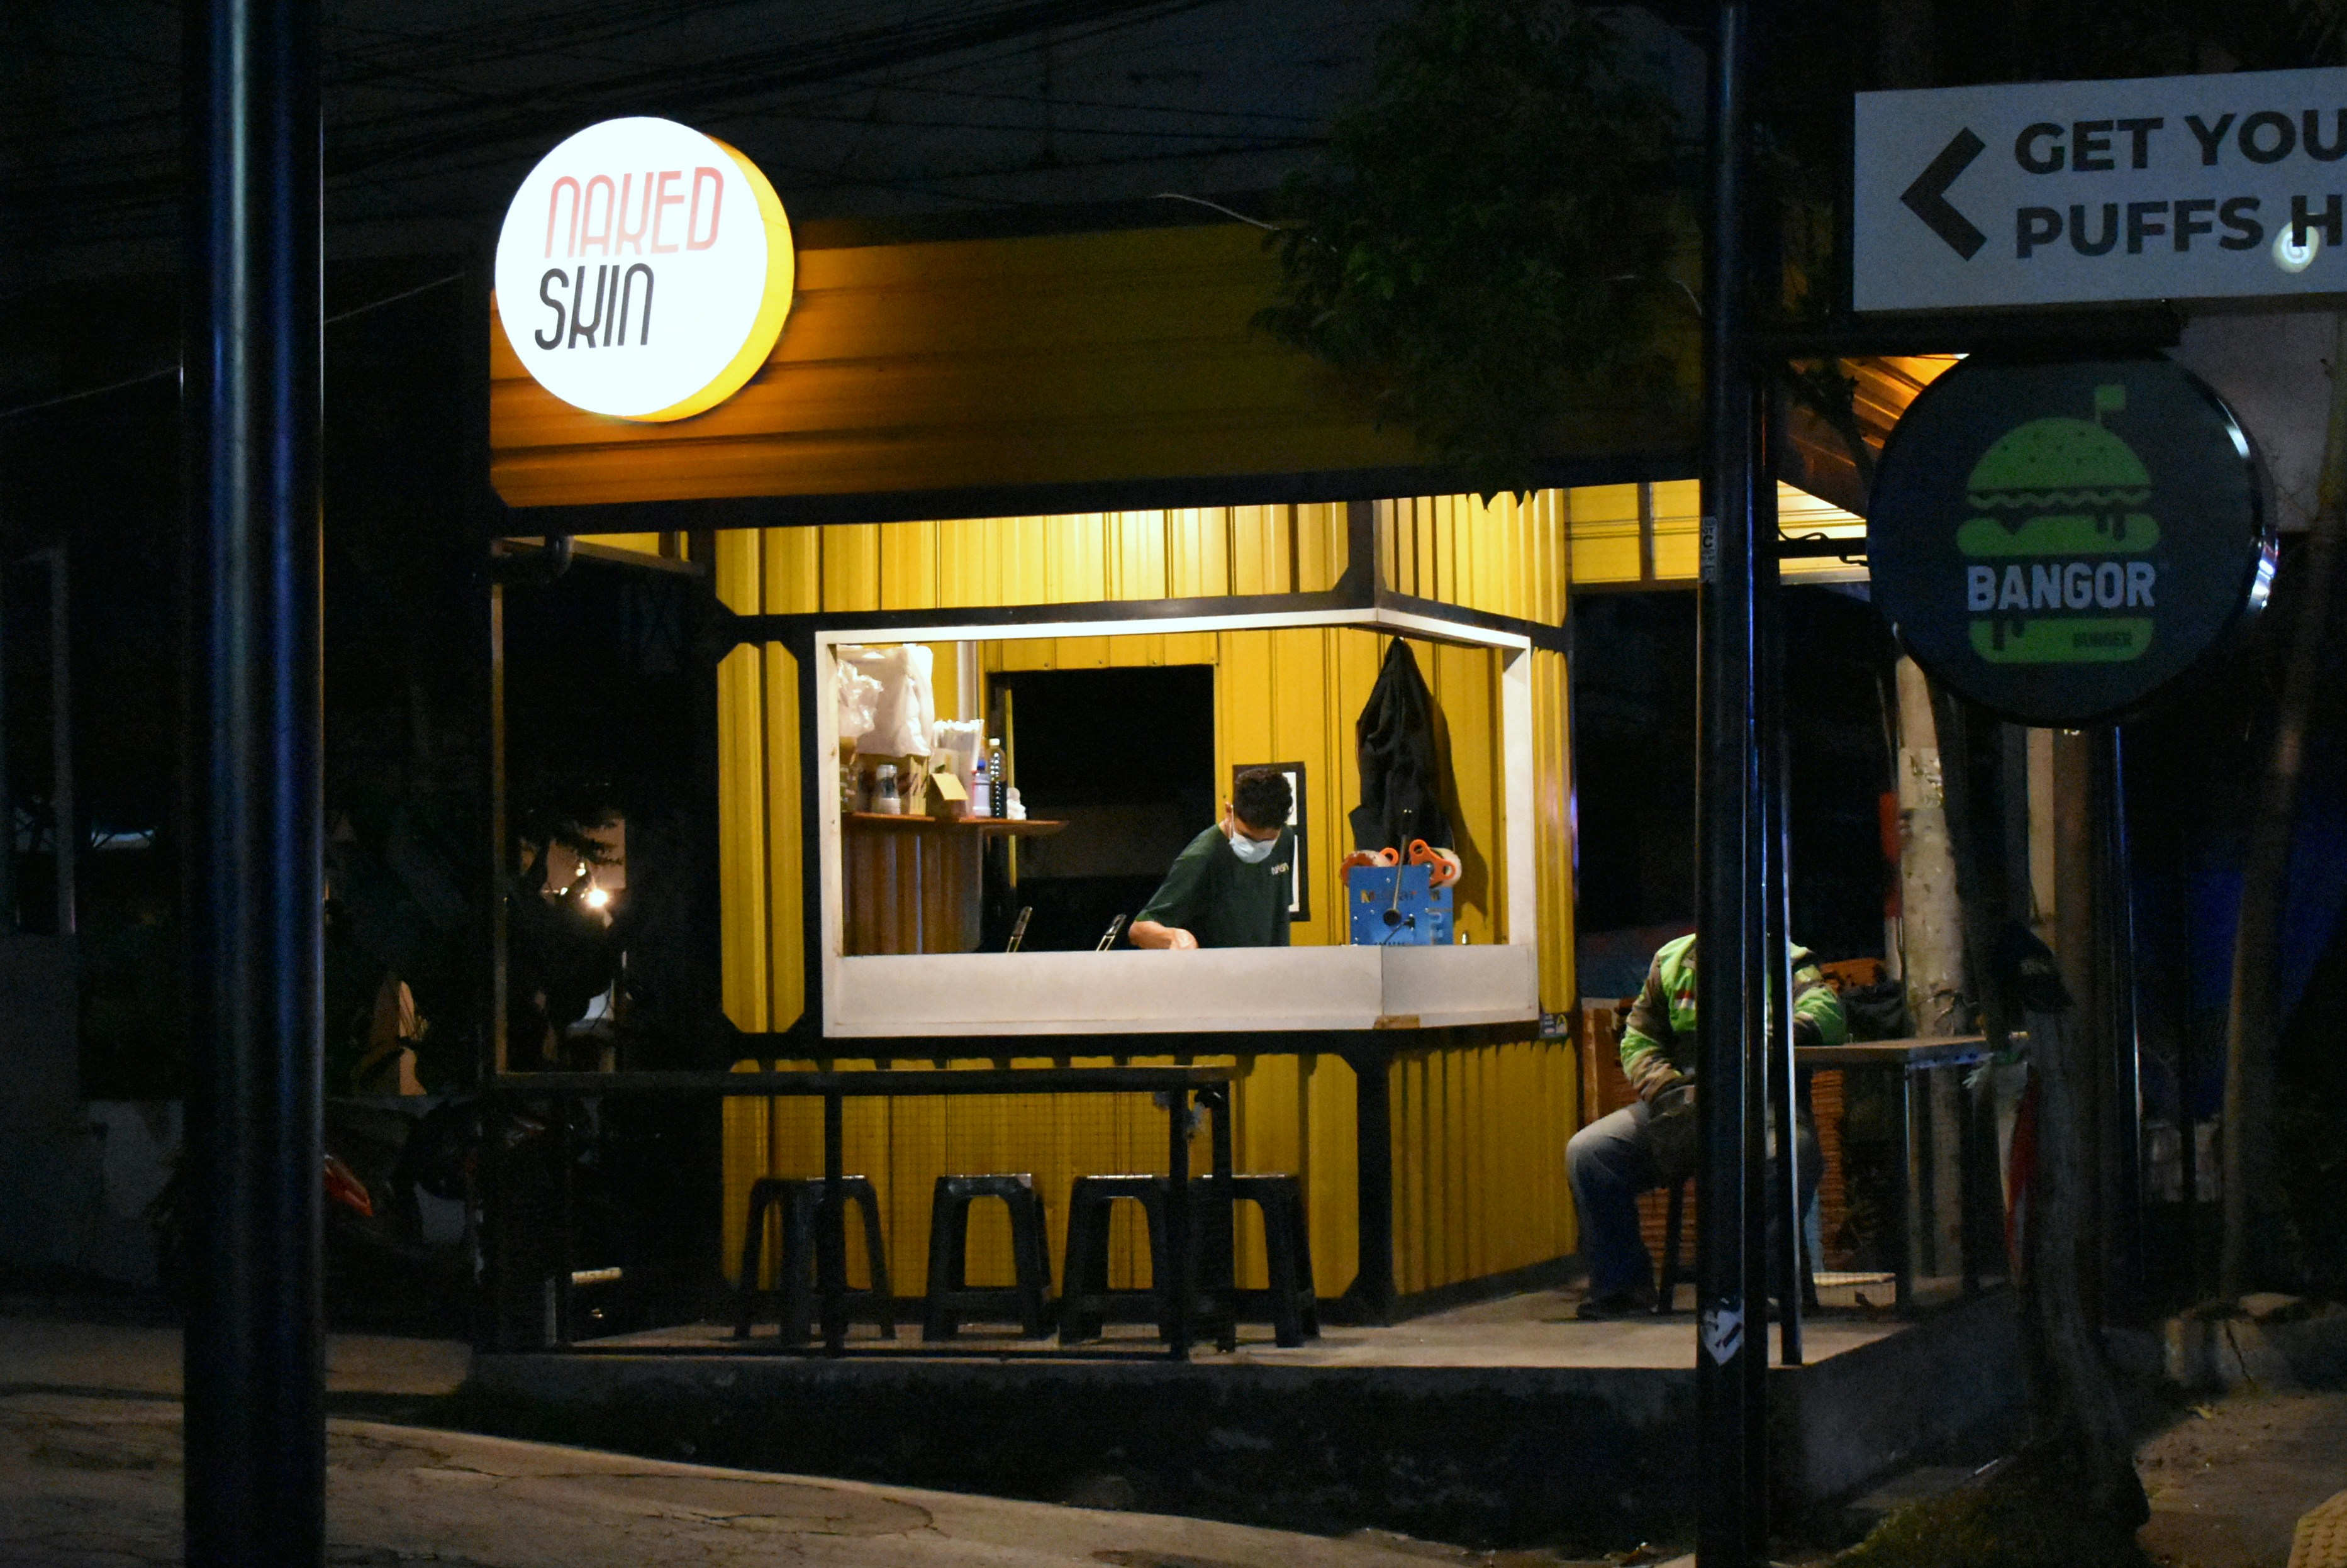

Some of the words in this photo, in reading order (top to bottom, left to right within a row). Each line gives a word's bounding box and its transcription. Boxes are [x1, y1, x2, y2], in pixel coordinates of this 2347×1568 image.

[2015, 117, 2164, 174] GET
[2185, 108, 2347, 166] YOU
[544, 166, 724, 259] NAKED
[2017, 196, 2264, 259] PUFFS
[2291, 194, 2344, 247] H
[534, 262, 655, 350] SKIN
[1967, 562, 2156, 612] BANGOR
